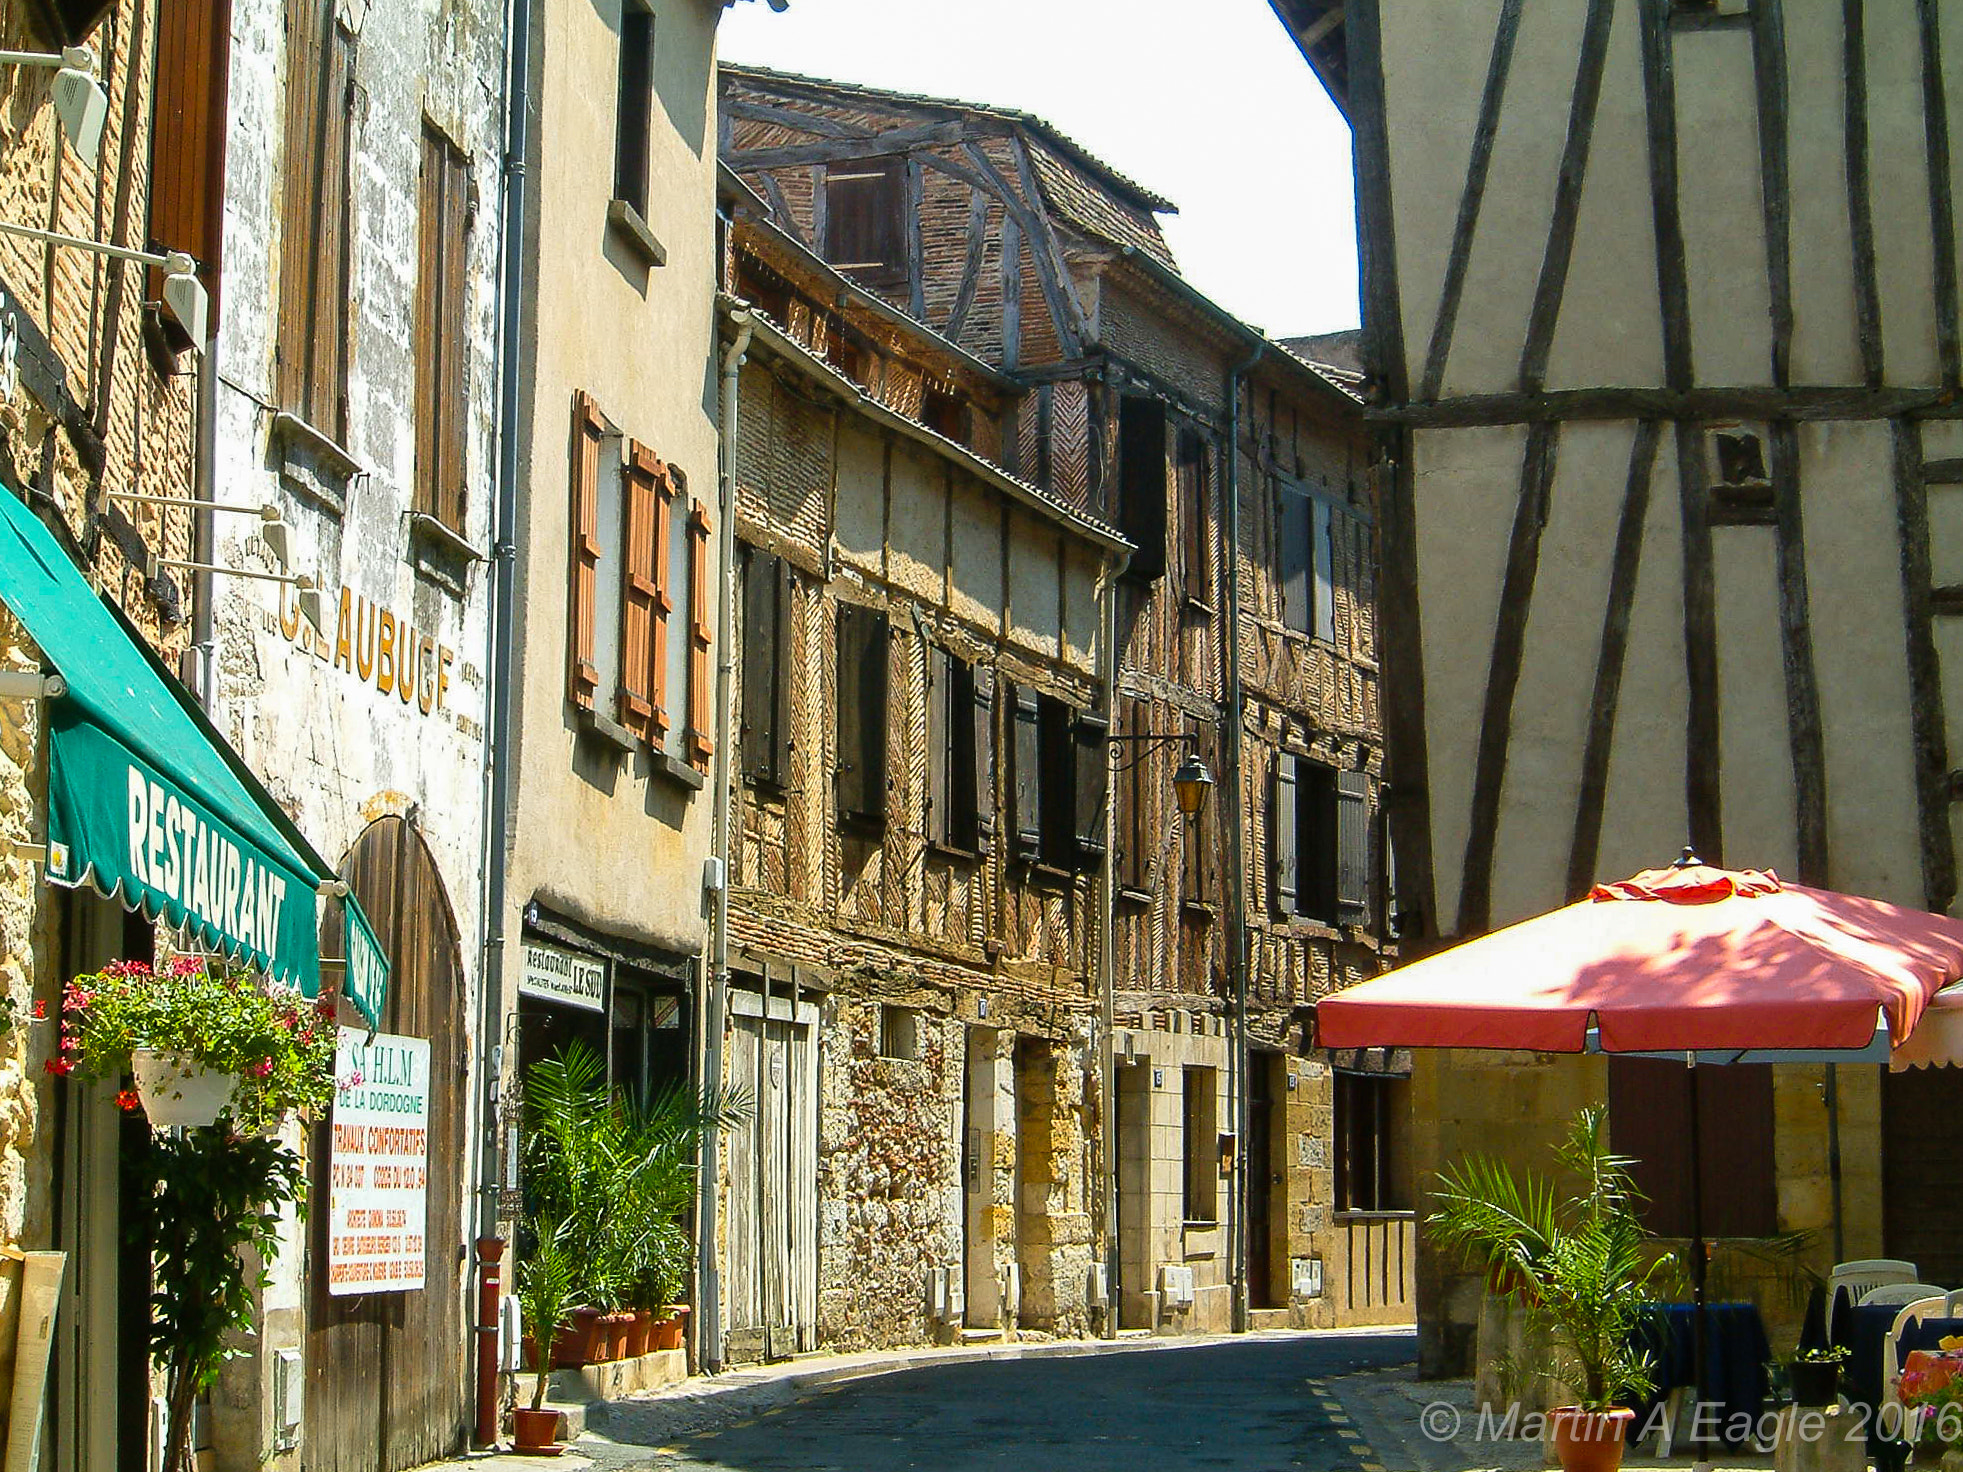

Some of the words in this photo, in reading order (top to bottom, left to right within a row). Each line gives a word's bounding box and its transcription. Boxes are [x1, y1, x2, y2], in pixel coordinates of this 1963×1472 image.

[127, 764, 286, 961] RESTAURANT
[585, 969, 602, 999] SUD
[355, 1090, 365, 1109] LA
[370, 1092, 423, 1114] DORDOGNE
[334, 1124, 365, 1154] TRAVAUX
[368, 1126, 425, 1156] CONFORTATIFS
